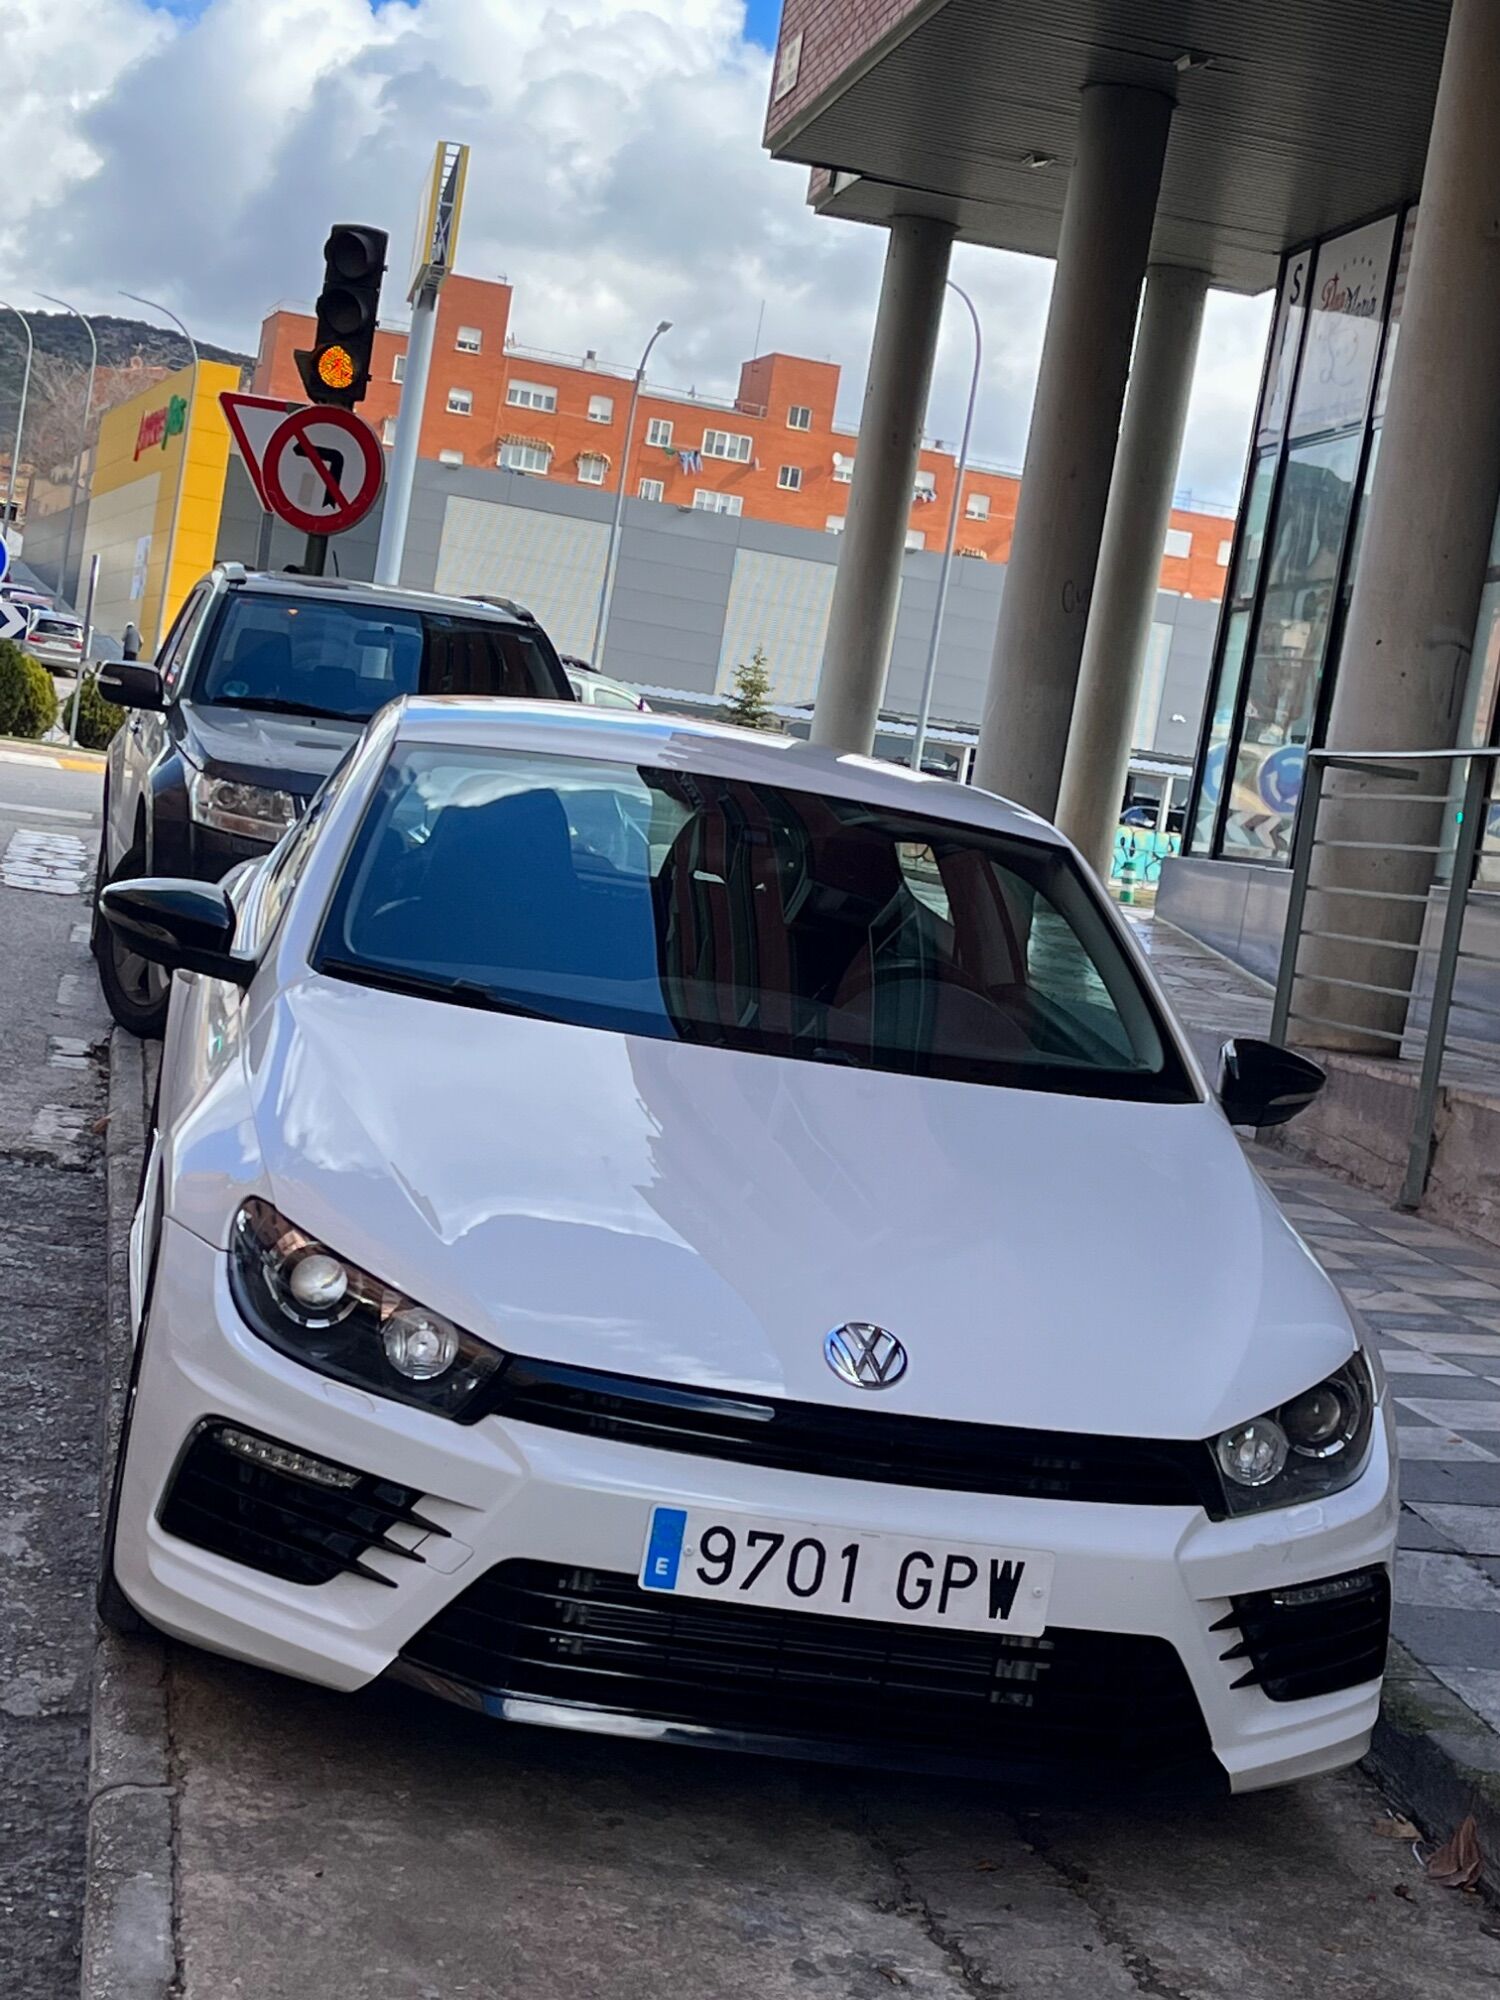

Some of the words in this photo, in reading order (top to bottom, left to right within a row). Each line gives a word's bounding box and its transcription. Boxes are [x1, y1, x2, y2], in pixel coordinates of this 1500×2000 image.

[655, 1557, 670, 1576] E
[696, 1525, 860, 1604] 9701
[896, 1550, 1026, 1621] GPW
